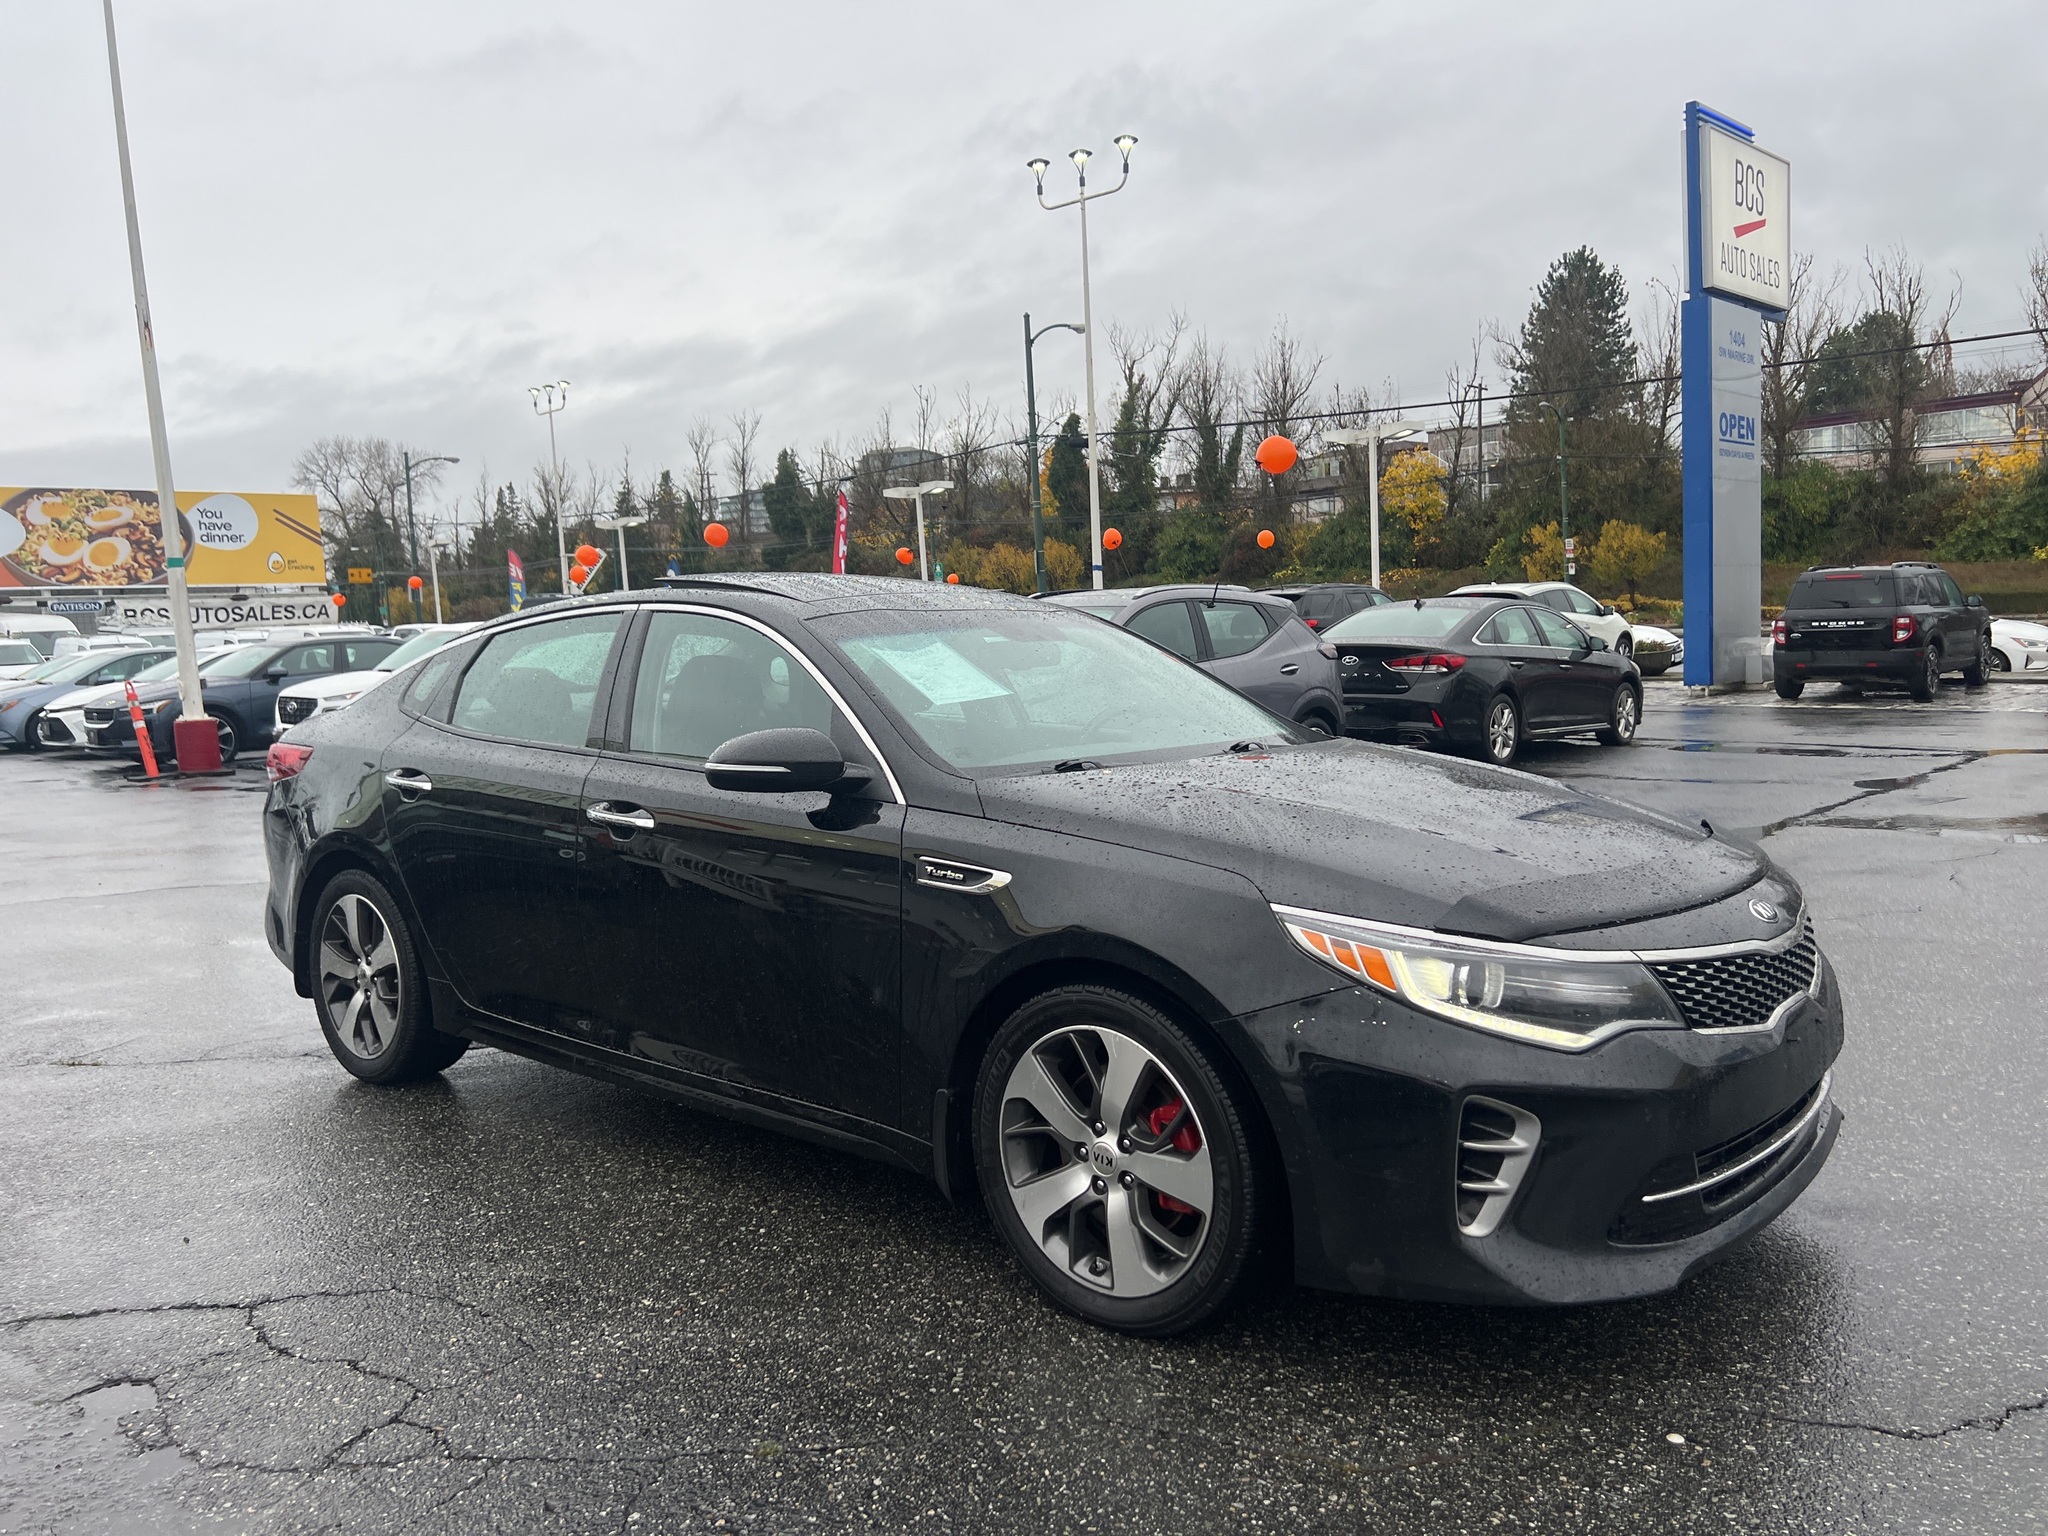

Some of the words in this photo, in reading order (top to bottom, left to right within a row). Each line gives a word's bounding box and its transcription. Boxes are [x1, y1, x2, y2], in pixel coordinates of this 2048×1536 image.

[1735, 158, 1765, 216] BCS
[1720, 242, 1747, 279] AUTO
[1749, 252, 1780, 289] SALES
[1729, 329, 1746, 348] 1404
[1719, 411, 1755, 441] OPEN
[196, 507, 223, 520] You
[198, 519, 233, 532] have
[200, 531, 247, 544] dinner.
[53, 600, 100, 612] PATTISON
[924, 864, 965, 882] Turbo
[1092, 1150, 1115, 1169] KIA
